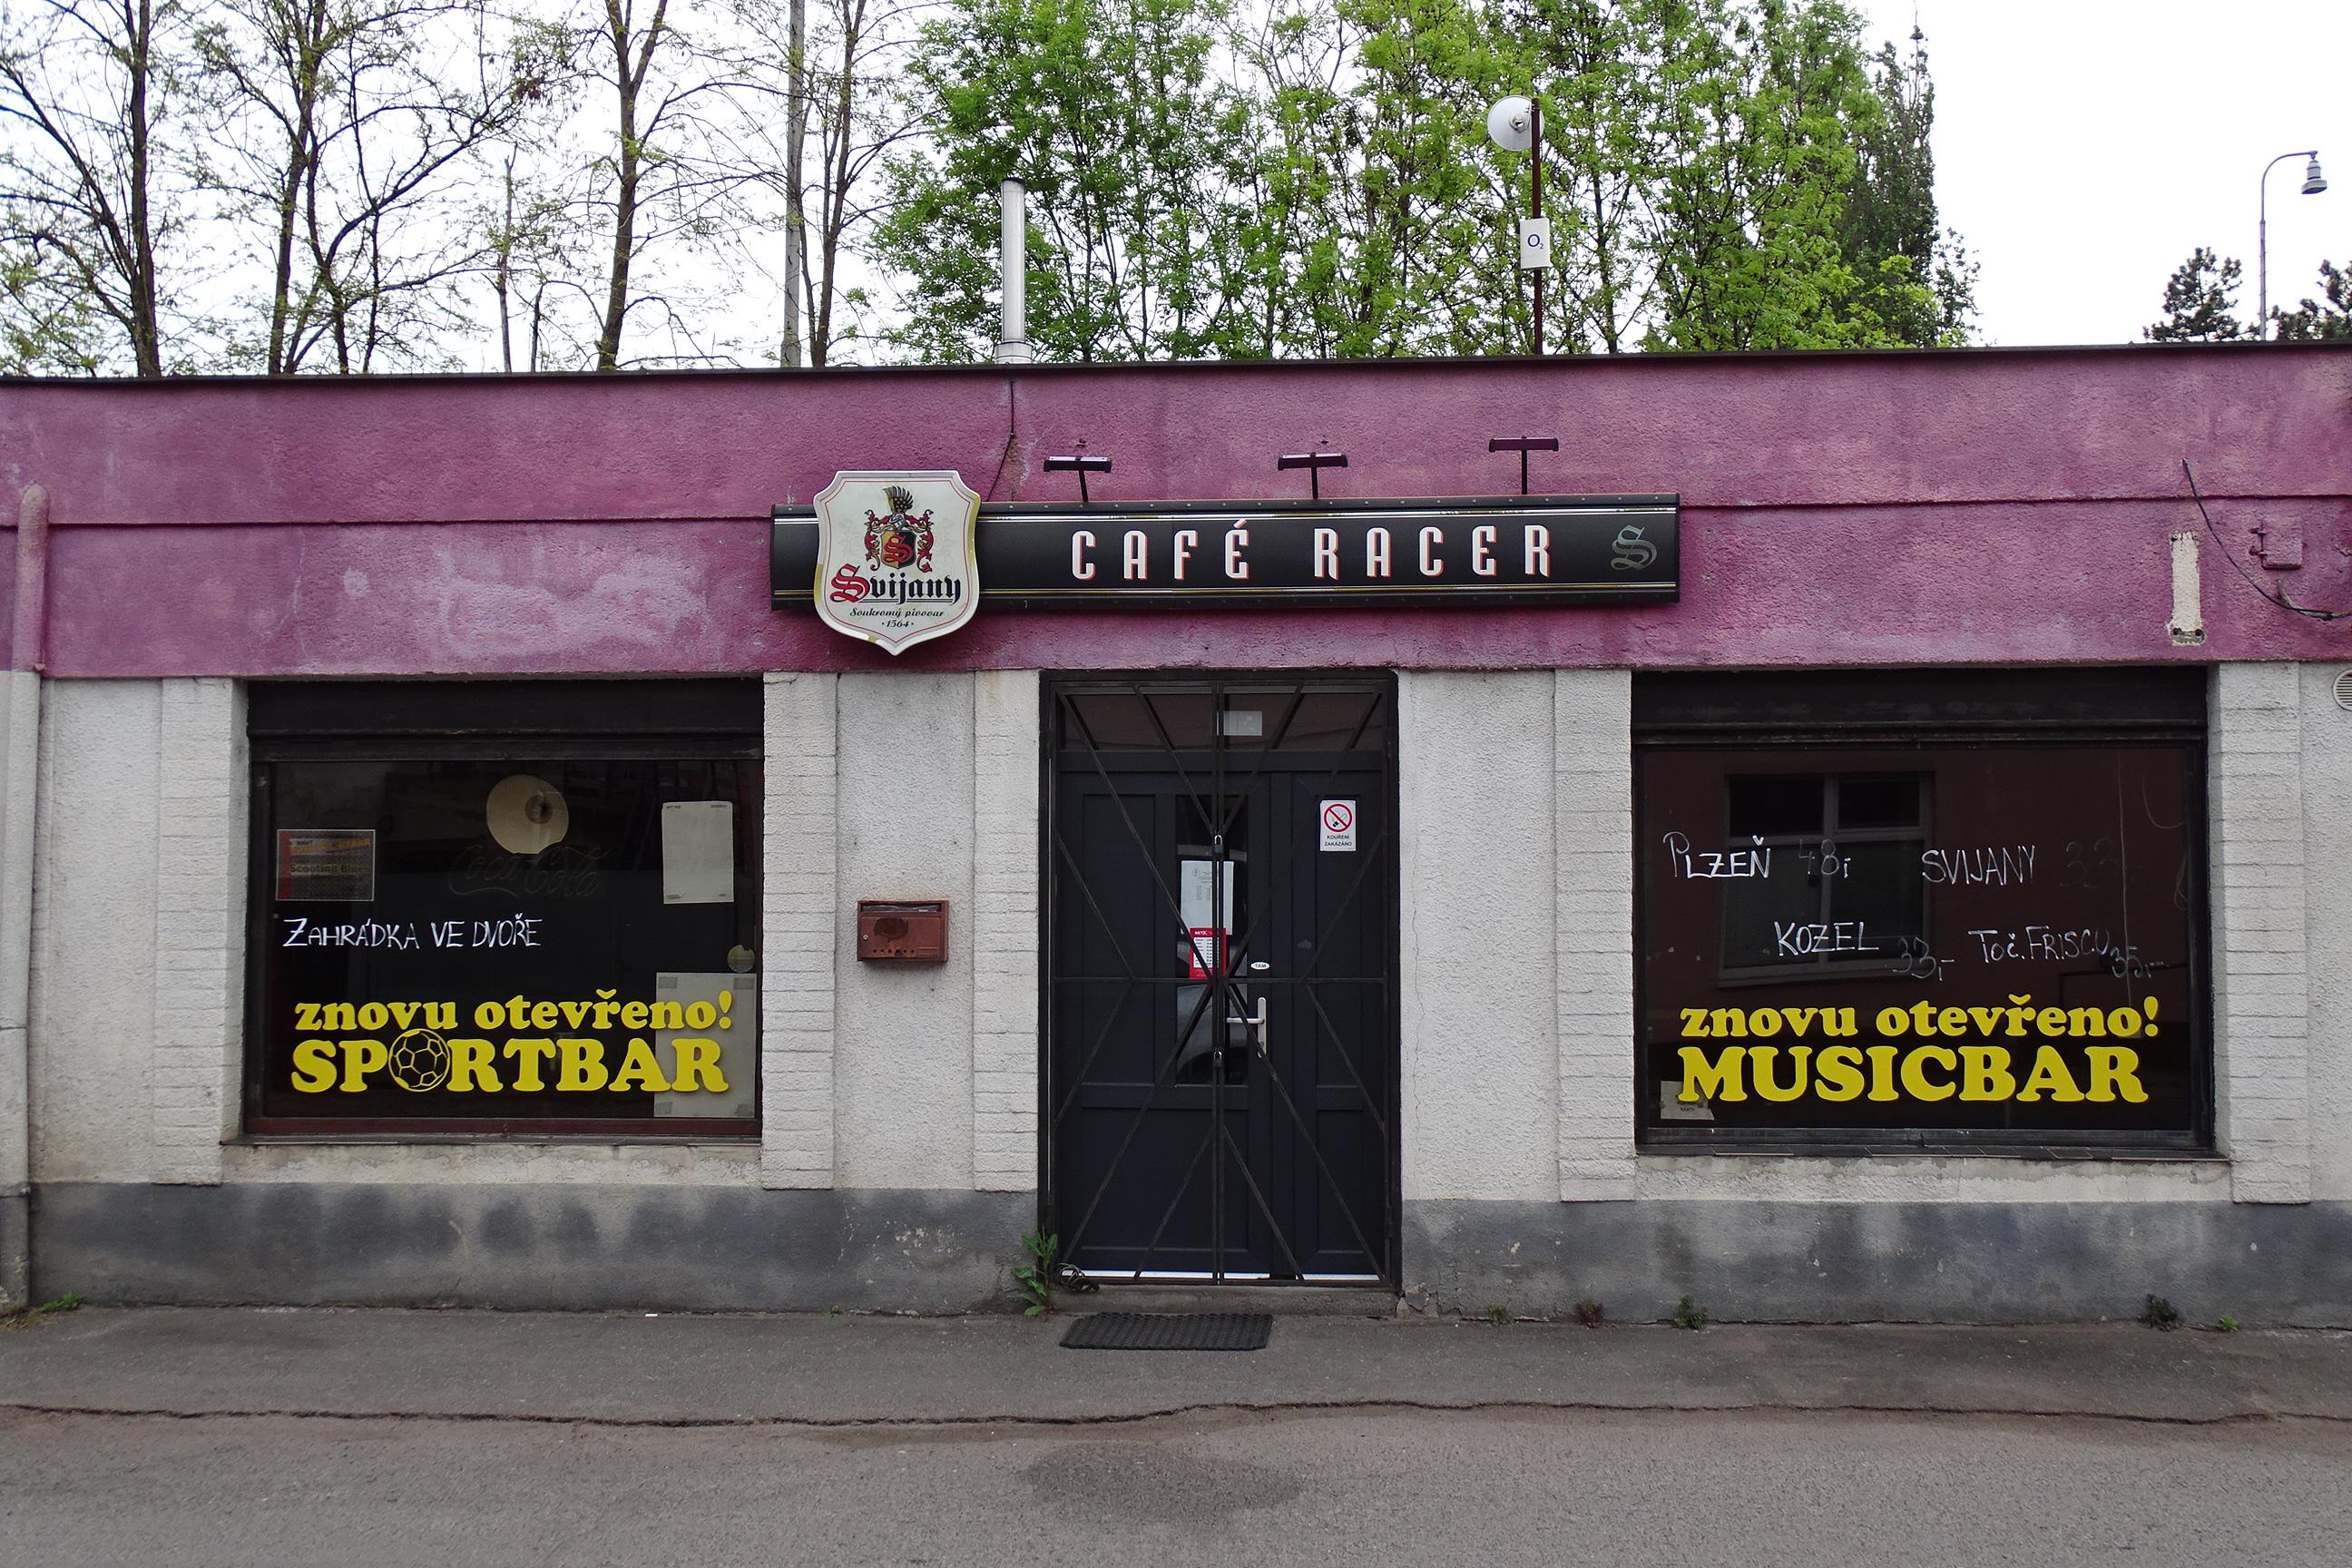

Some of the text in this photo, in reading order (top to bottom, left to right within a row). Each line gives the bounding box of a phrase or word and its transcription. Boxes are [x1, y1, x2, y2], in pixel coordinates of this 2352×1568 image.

[1072, 518, 1551, 581] CAFÉ RACER
[829, 563, 961, 605] Svijany
[849, 607, 944, 618] Soukromý pivovar
[1662, 831, 1770, 878] PLZEŇ
[1922, 845, 2035, 886] SVIJANY
[283, 914, 543, 951] ZAHRÁDKA VE DVOŘE
[1774, 920, 1879, 956] KOZEL
[294, 988, 732, 1031] znovu otevřeno!
[1681, 994, 2159, 1037] znovu otevřeno!
[1678, 1045, 2150, 1103] MUSICBAR
